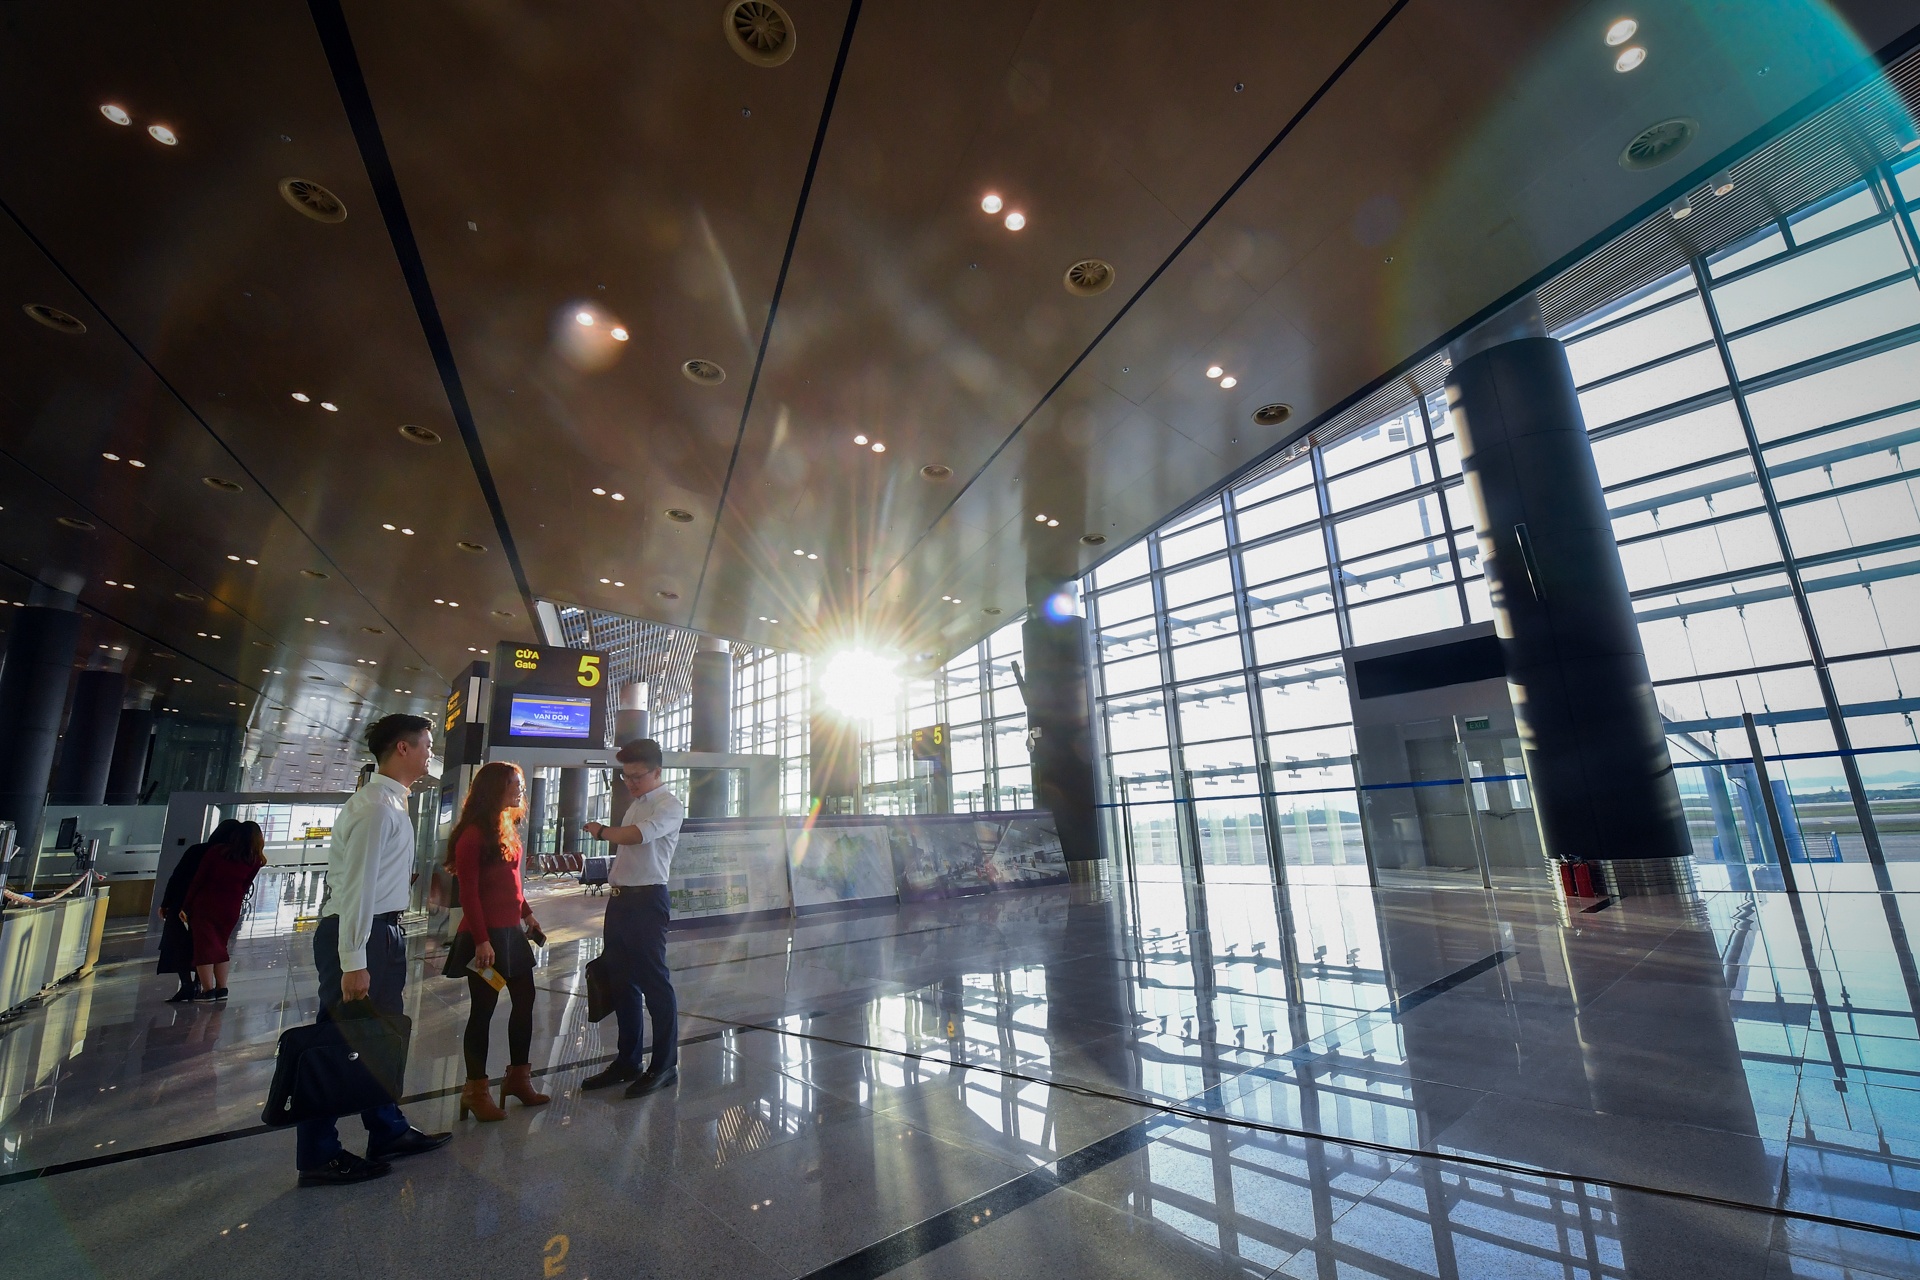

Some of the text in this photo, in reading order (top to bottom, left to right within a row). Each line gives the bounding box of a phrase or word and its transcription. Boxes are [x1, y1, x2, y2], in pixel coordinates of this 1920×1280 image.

[515, 648, 540, 660] CỬA
[514, 659, 537, 670] Gate
[577, 655, 601, 687] 5
[1469, 721, 1486, 729] EXIT
[933, 726, 942, 745] 5
